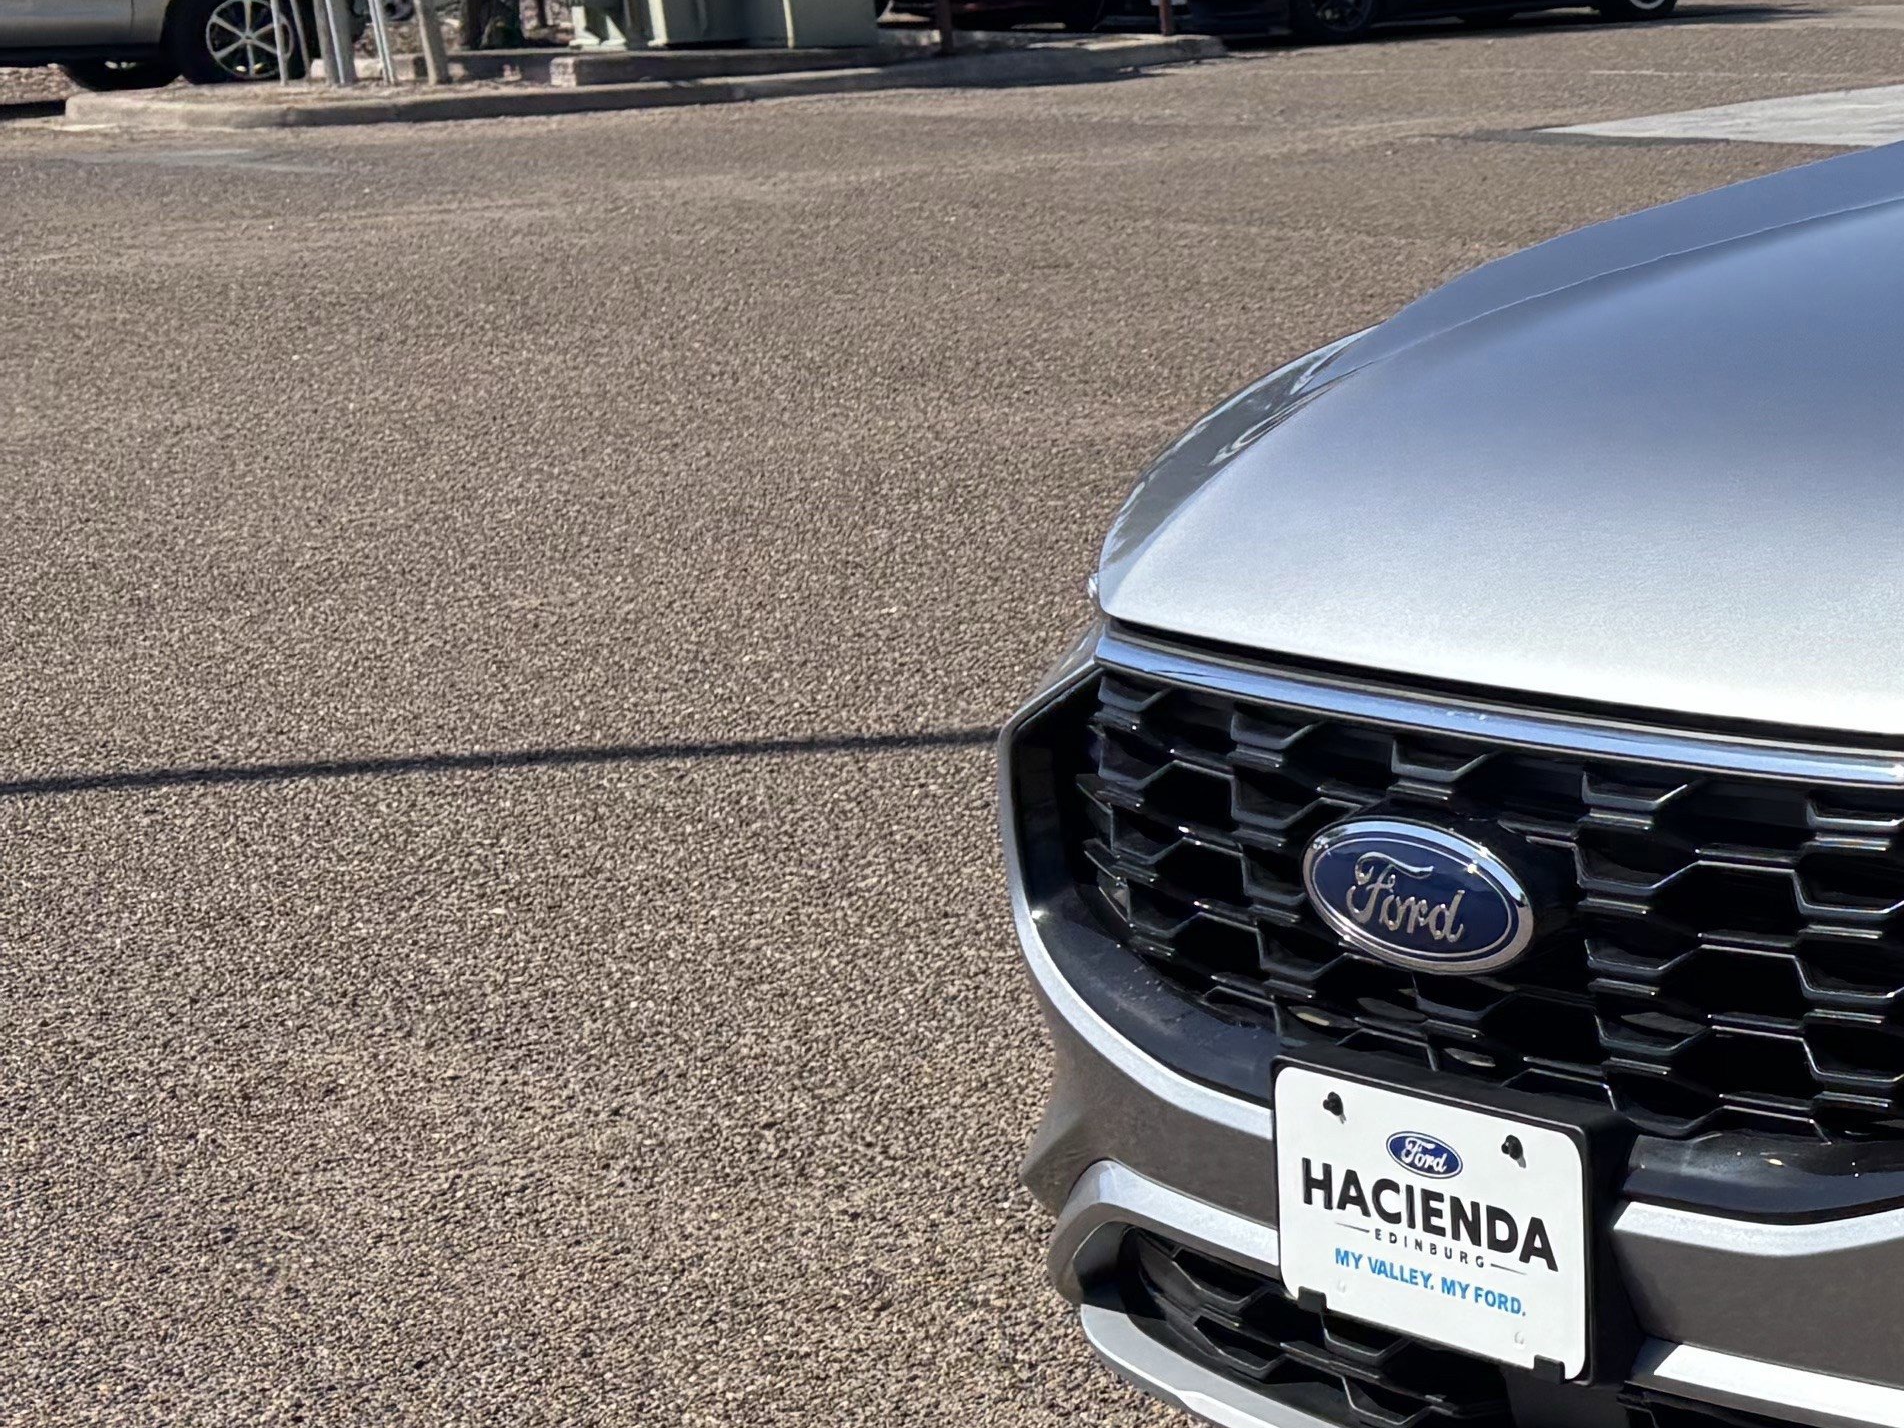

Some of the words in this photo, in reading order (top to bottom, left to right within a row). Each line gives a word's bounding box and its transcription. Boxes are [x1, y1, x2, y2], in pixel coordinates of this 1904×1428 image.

[1346, 851, 1465, 943] Ford
[1400, 1138, 1448, 1173] Ford
[1302, 1157, 1559, 1273] HACIENDA
[1374, 1228, 1485, 1269] EDINBURG
[1335, 1248, 1363, 1270] MY
[1367, 1256, 1435, 1291] VALLEY.
[1441, 1276, 1471, 1300] MY
[1474, 1285, 1527, 1317] FORD.
